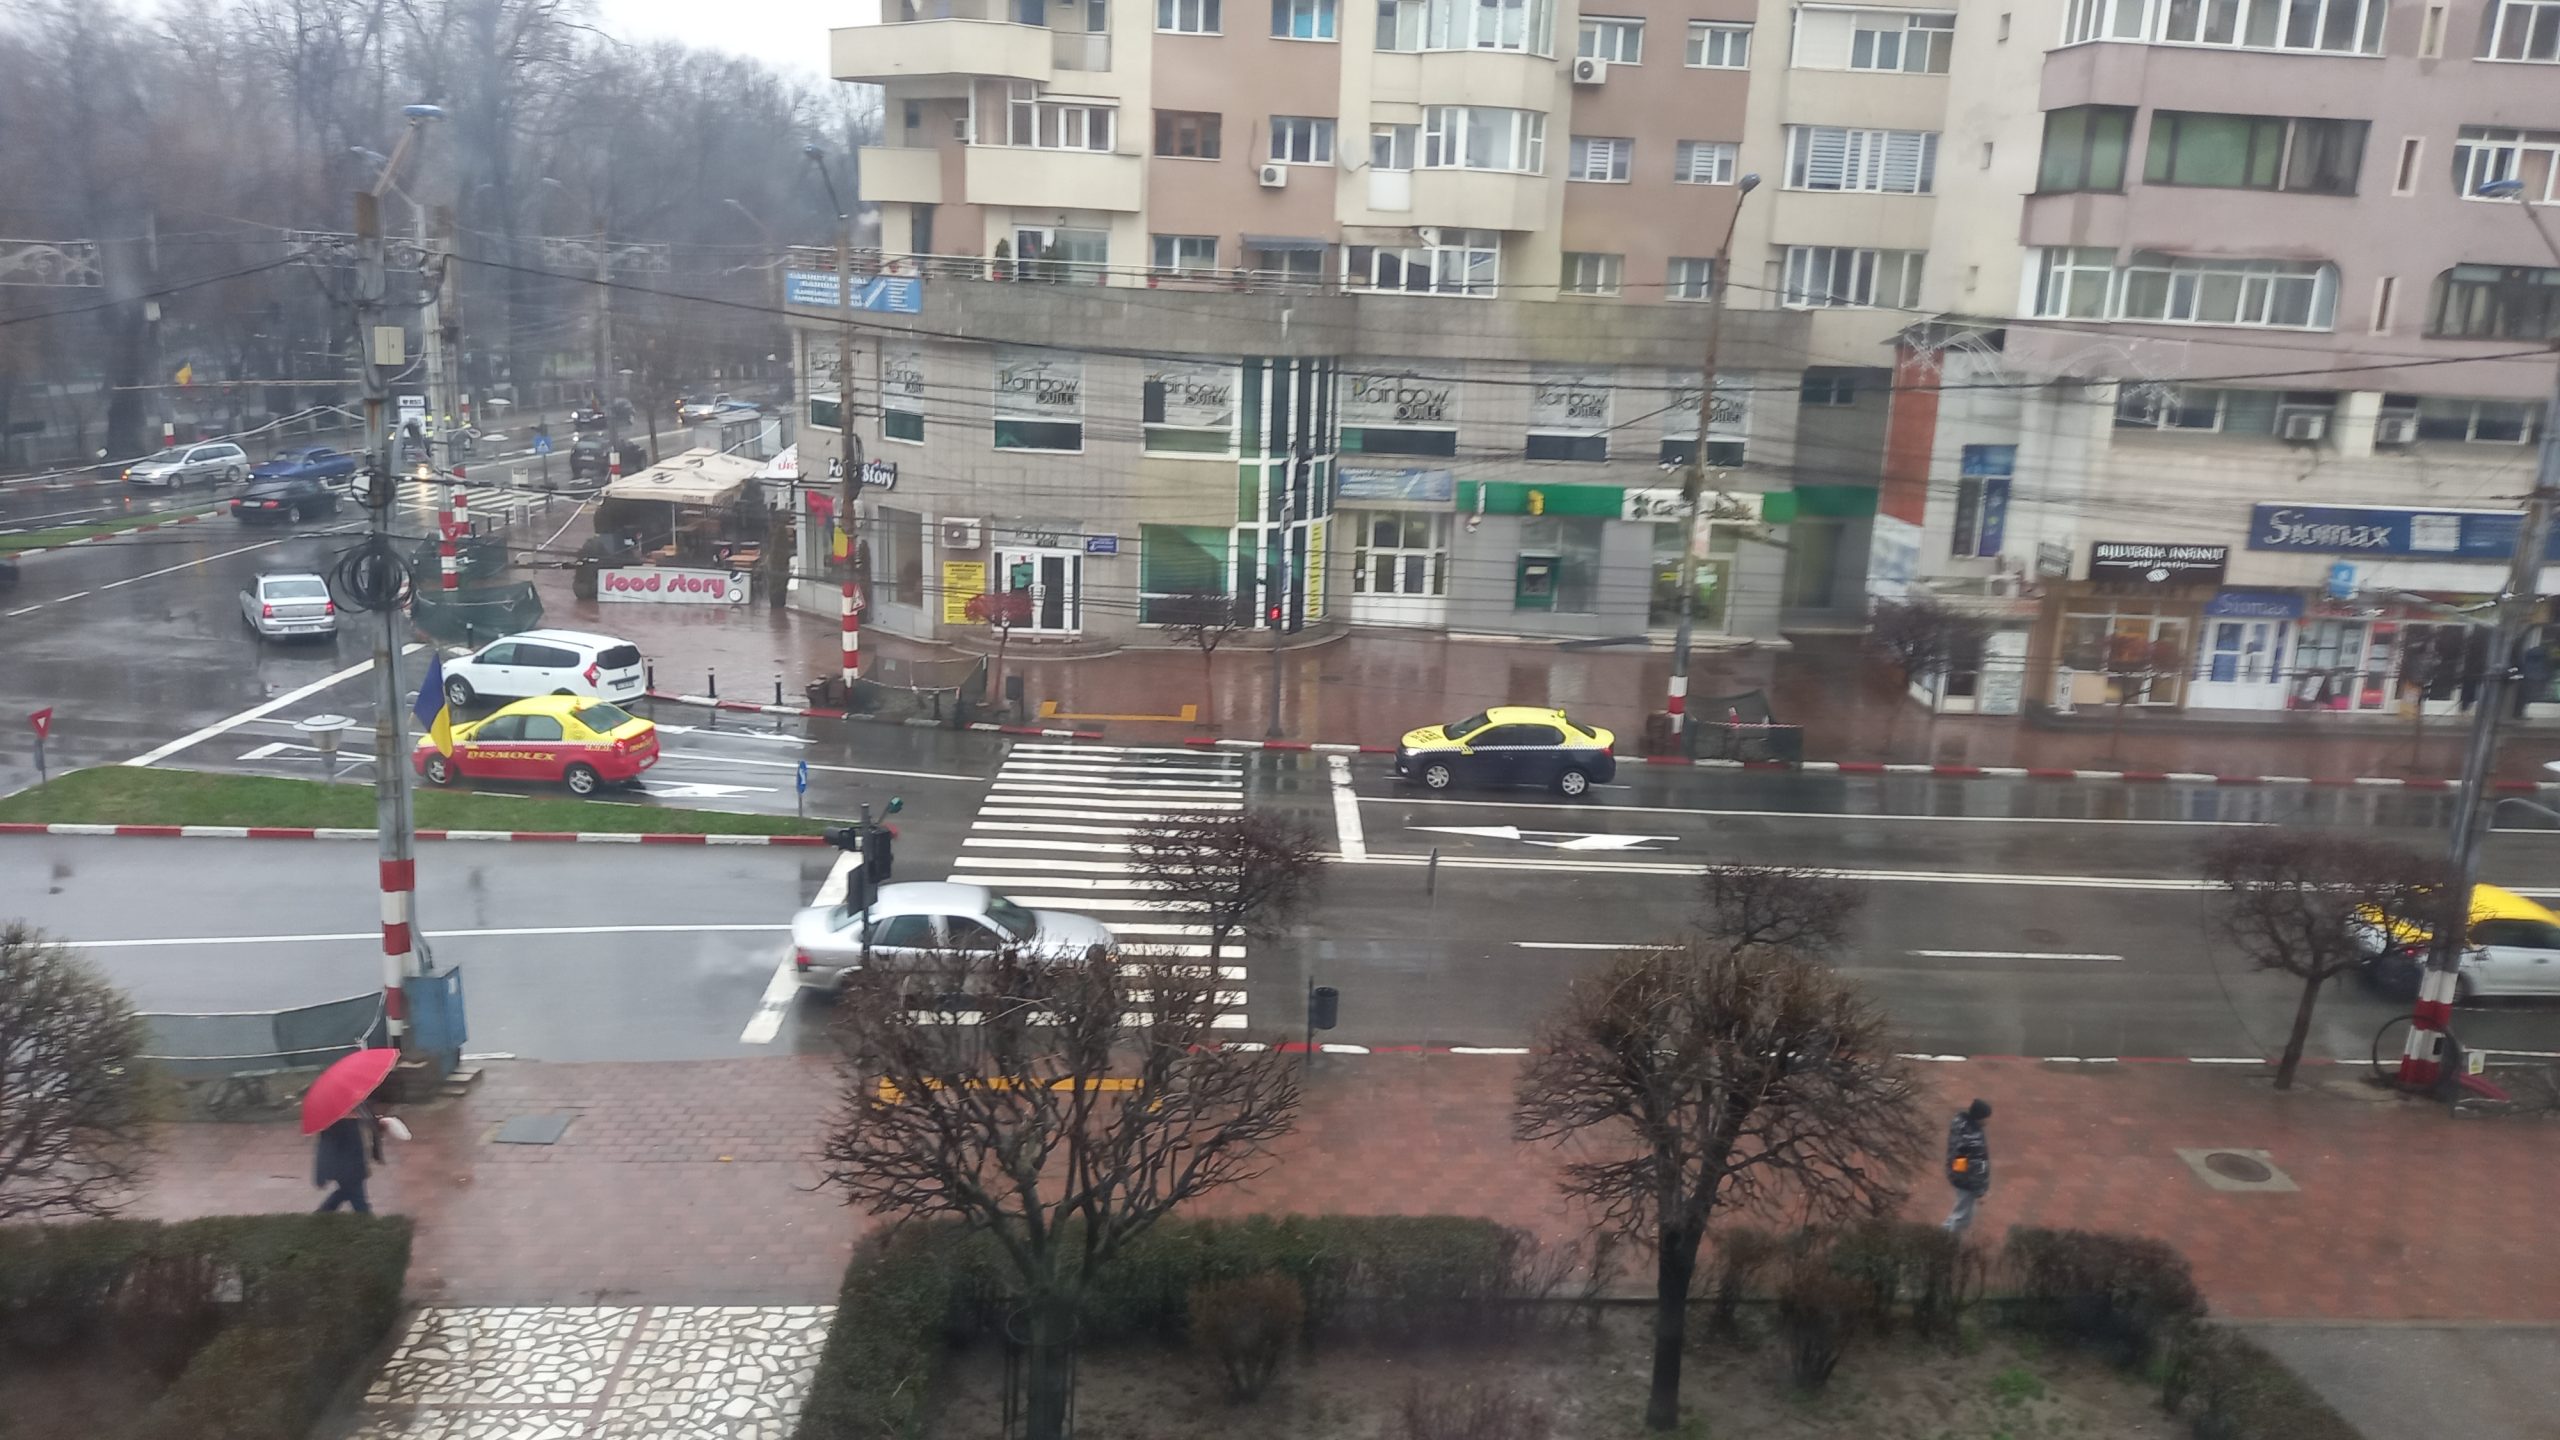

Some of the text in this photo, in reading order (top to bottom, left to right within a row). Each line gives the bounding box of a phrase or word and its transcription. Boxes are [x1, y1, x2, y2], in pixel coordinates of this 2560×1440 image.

[1000, 369, 1079, 392] Rainbow
[1352, 377, 1449, 404] Rainbow
[605, 572, 725, 599] food story
[467, 750, 557, 761] DISMOLEX
